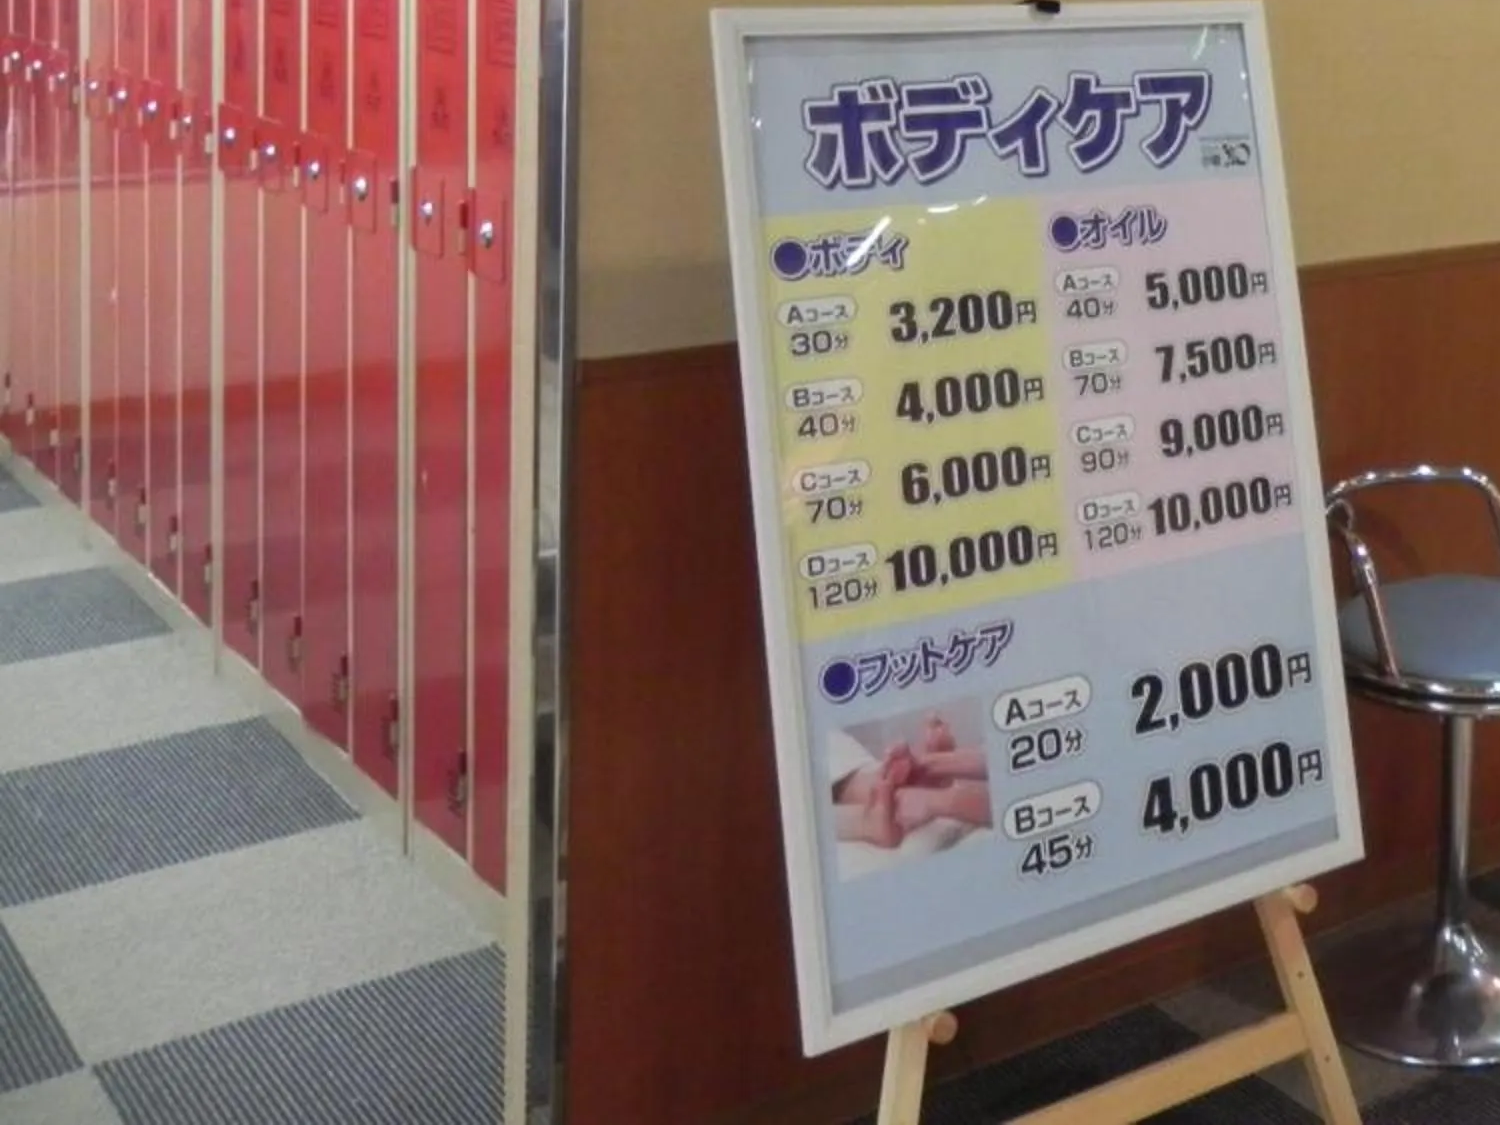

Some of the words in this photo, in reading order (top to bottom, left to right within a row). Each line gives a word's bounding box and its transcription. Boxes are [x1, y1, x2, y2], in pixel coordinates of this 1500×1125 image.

[804, 71, 1212, 188] ボディケア
[1081, 207, 1168, 248] オイル
[810, 233, 910, 275] ボディ
[1062, 271, 1113, 291] Aコース
[1146, 263, 1269, 312] 5,000円
[1066, 297, 1115, 319] 40分
[786, 301, 850, 324] Aコース
[889, 290, 1038, 344] 3,200円
[790, 329, 849, 357] 30分
[1069, 347, 1120, 368] Bコース
[1155, 333, 1277, 384] 7,500円
[793, 385, 855, 408] Bコース
[896, 368, 1045, 425] 4,000円
[1074, 372, 1121, 396] 70分
[797, 411, 856, 438] 40分
[1076, 425, 1127, 445] Cコース
[1160, 404, 1285, 459] 9,000円
[800, 467, 863, 492] Cコース
[900, 445, 1051, 506] 6,000円
[1080, 447, 1129, 474] 90分
[805, 494, 864, 524] 70分
[1148, 475, 1292, 537] 10,000円
[807, 548, 871, 575] Dコース
[884, 524, 1058, 593] 10,000円
[1086, 521, 1142, 552] 120分
[808, 577, 879, 610] 120分
[859, 620, 1013, 696] フットケア
[1004, 688, 1083, 726] Aコース
[1130, 643, 1313, 736] 2,000円
[1009, 727, 1085, 771] 20分
[1013, 793, 1092, 833] Bコース
[1142, 741, 1324, 835] 4,000円
[1019, 834, 1095, 876] 45分
